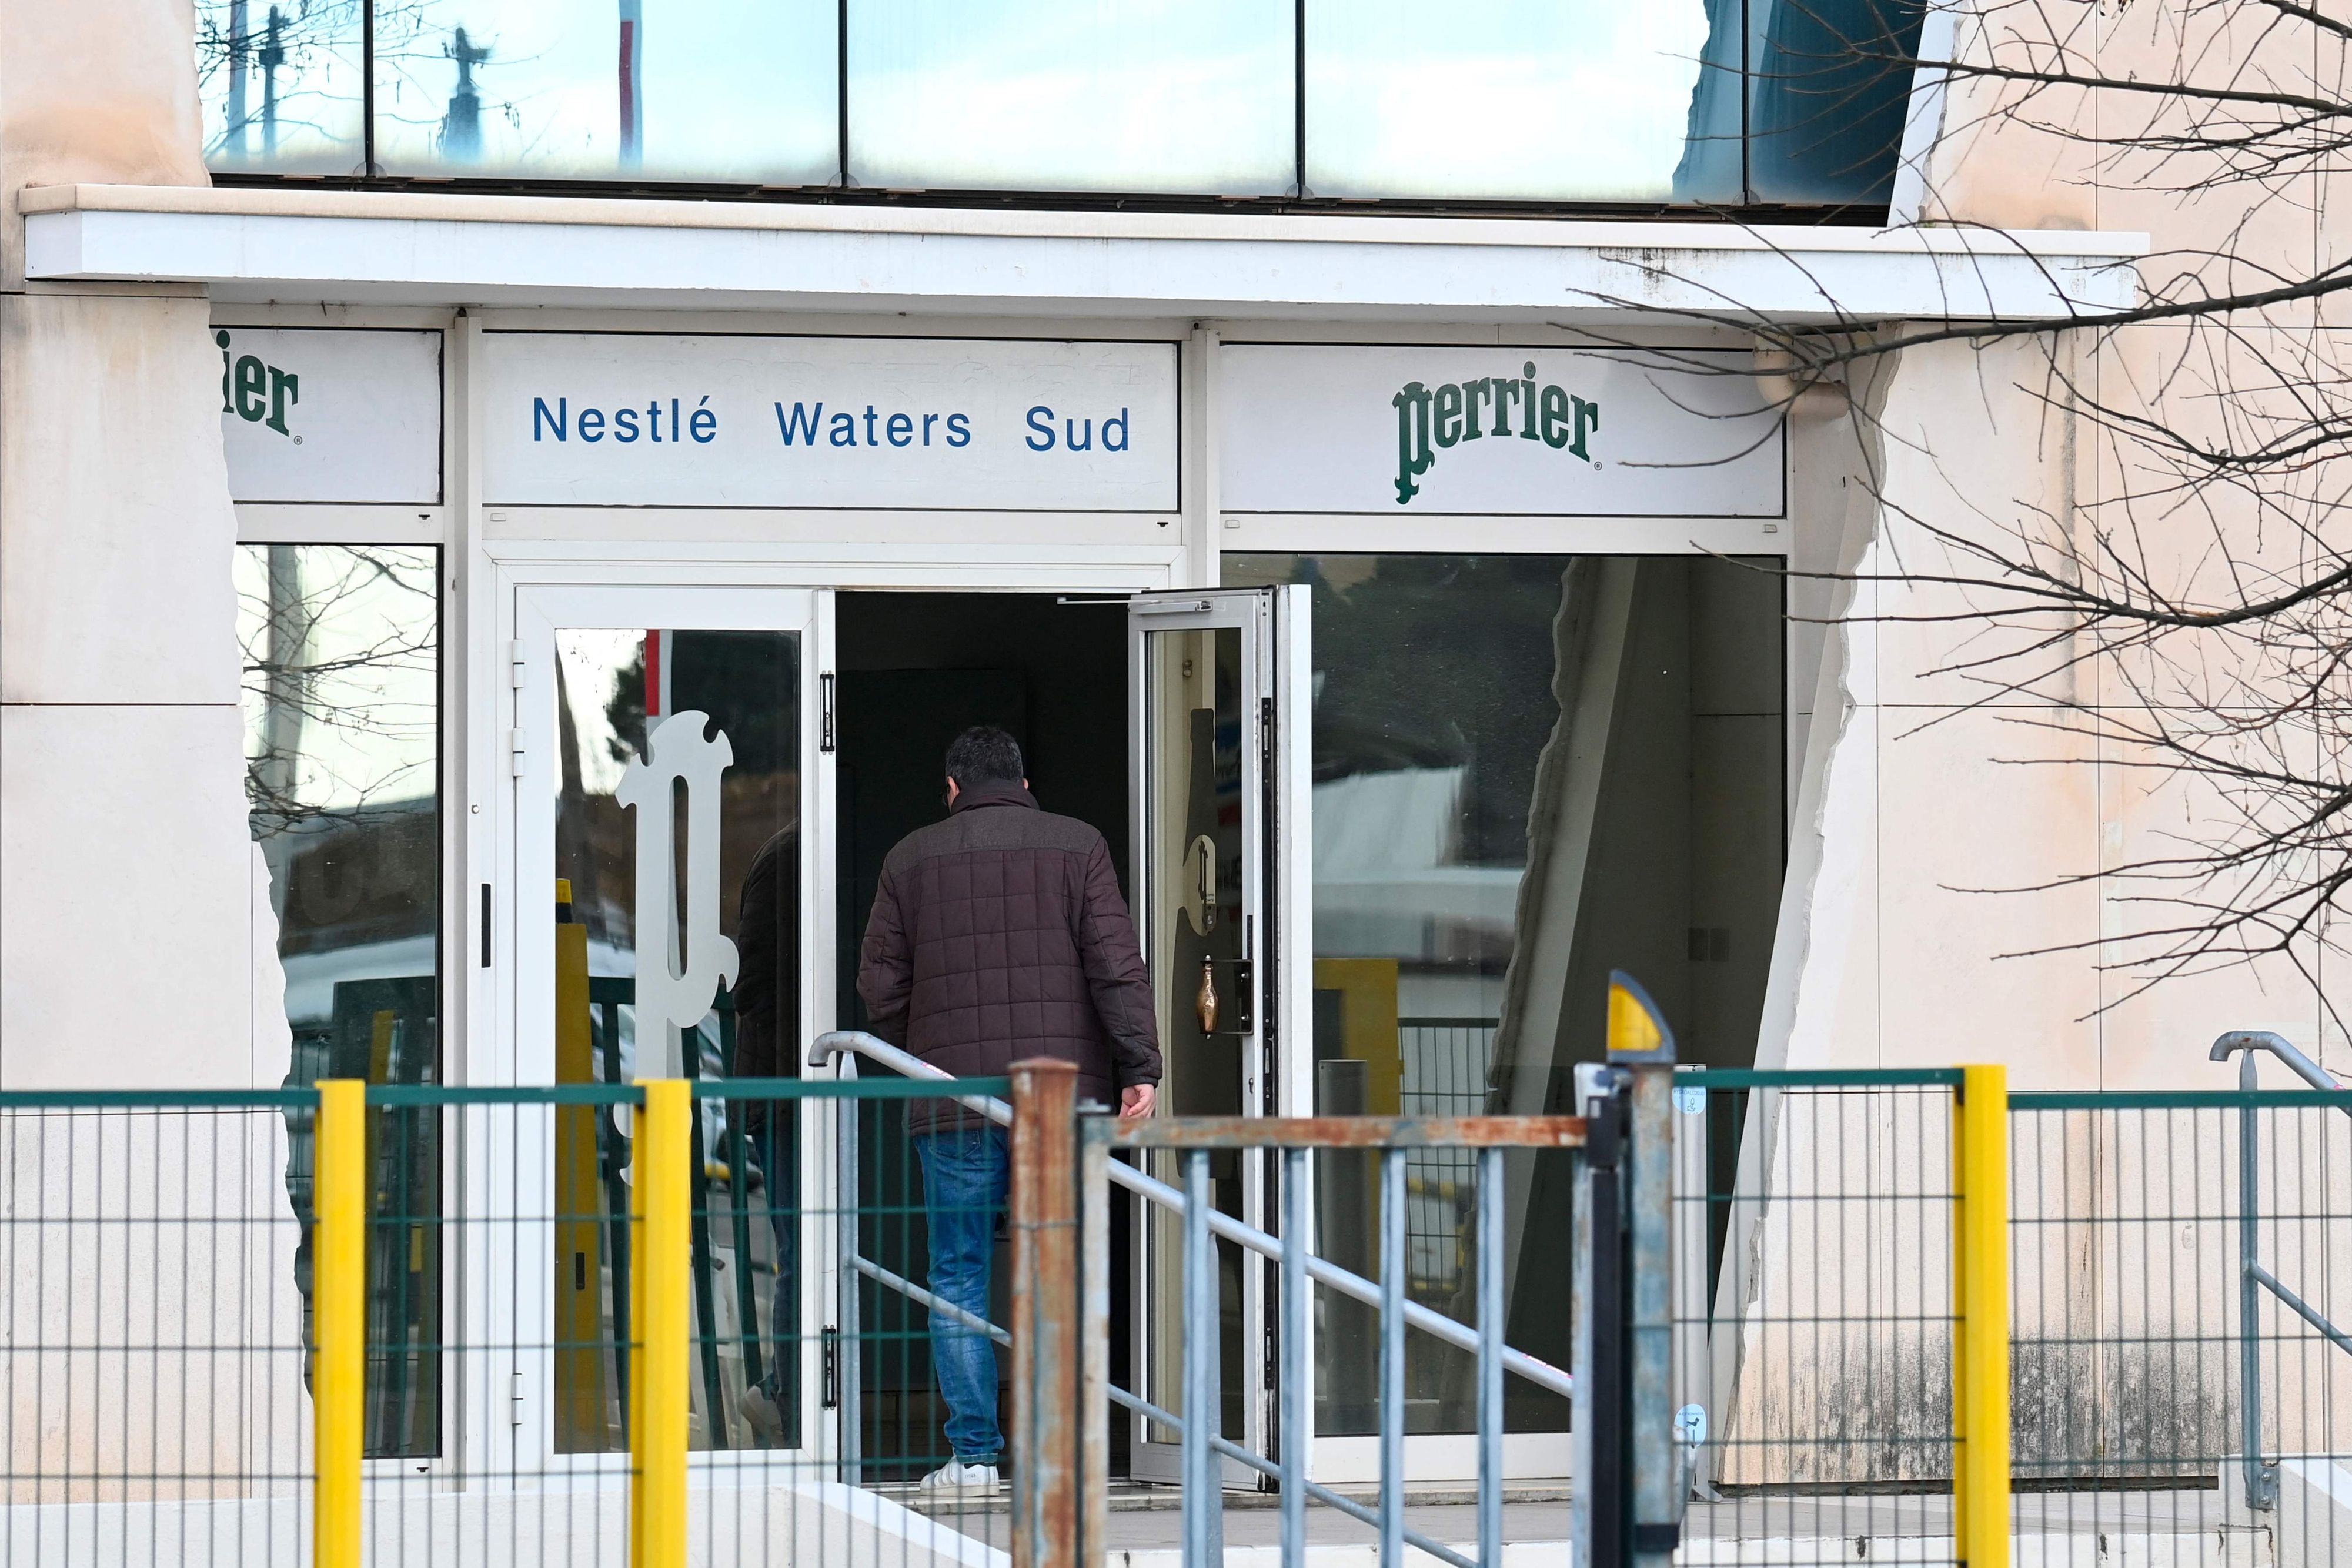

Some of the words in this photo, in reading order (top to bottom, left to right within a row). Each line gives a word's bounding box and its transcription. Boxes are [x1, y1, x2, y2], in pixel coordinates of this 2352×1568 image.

[533, 395, 717, 443] Nestlé
[774, 402, 971, 447] Waters
[1025, 406, 1130, 452] Sud
[1392, 361, 1598, 504] perrier
